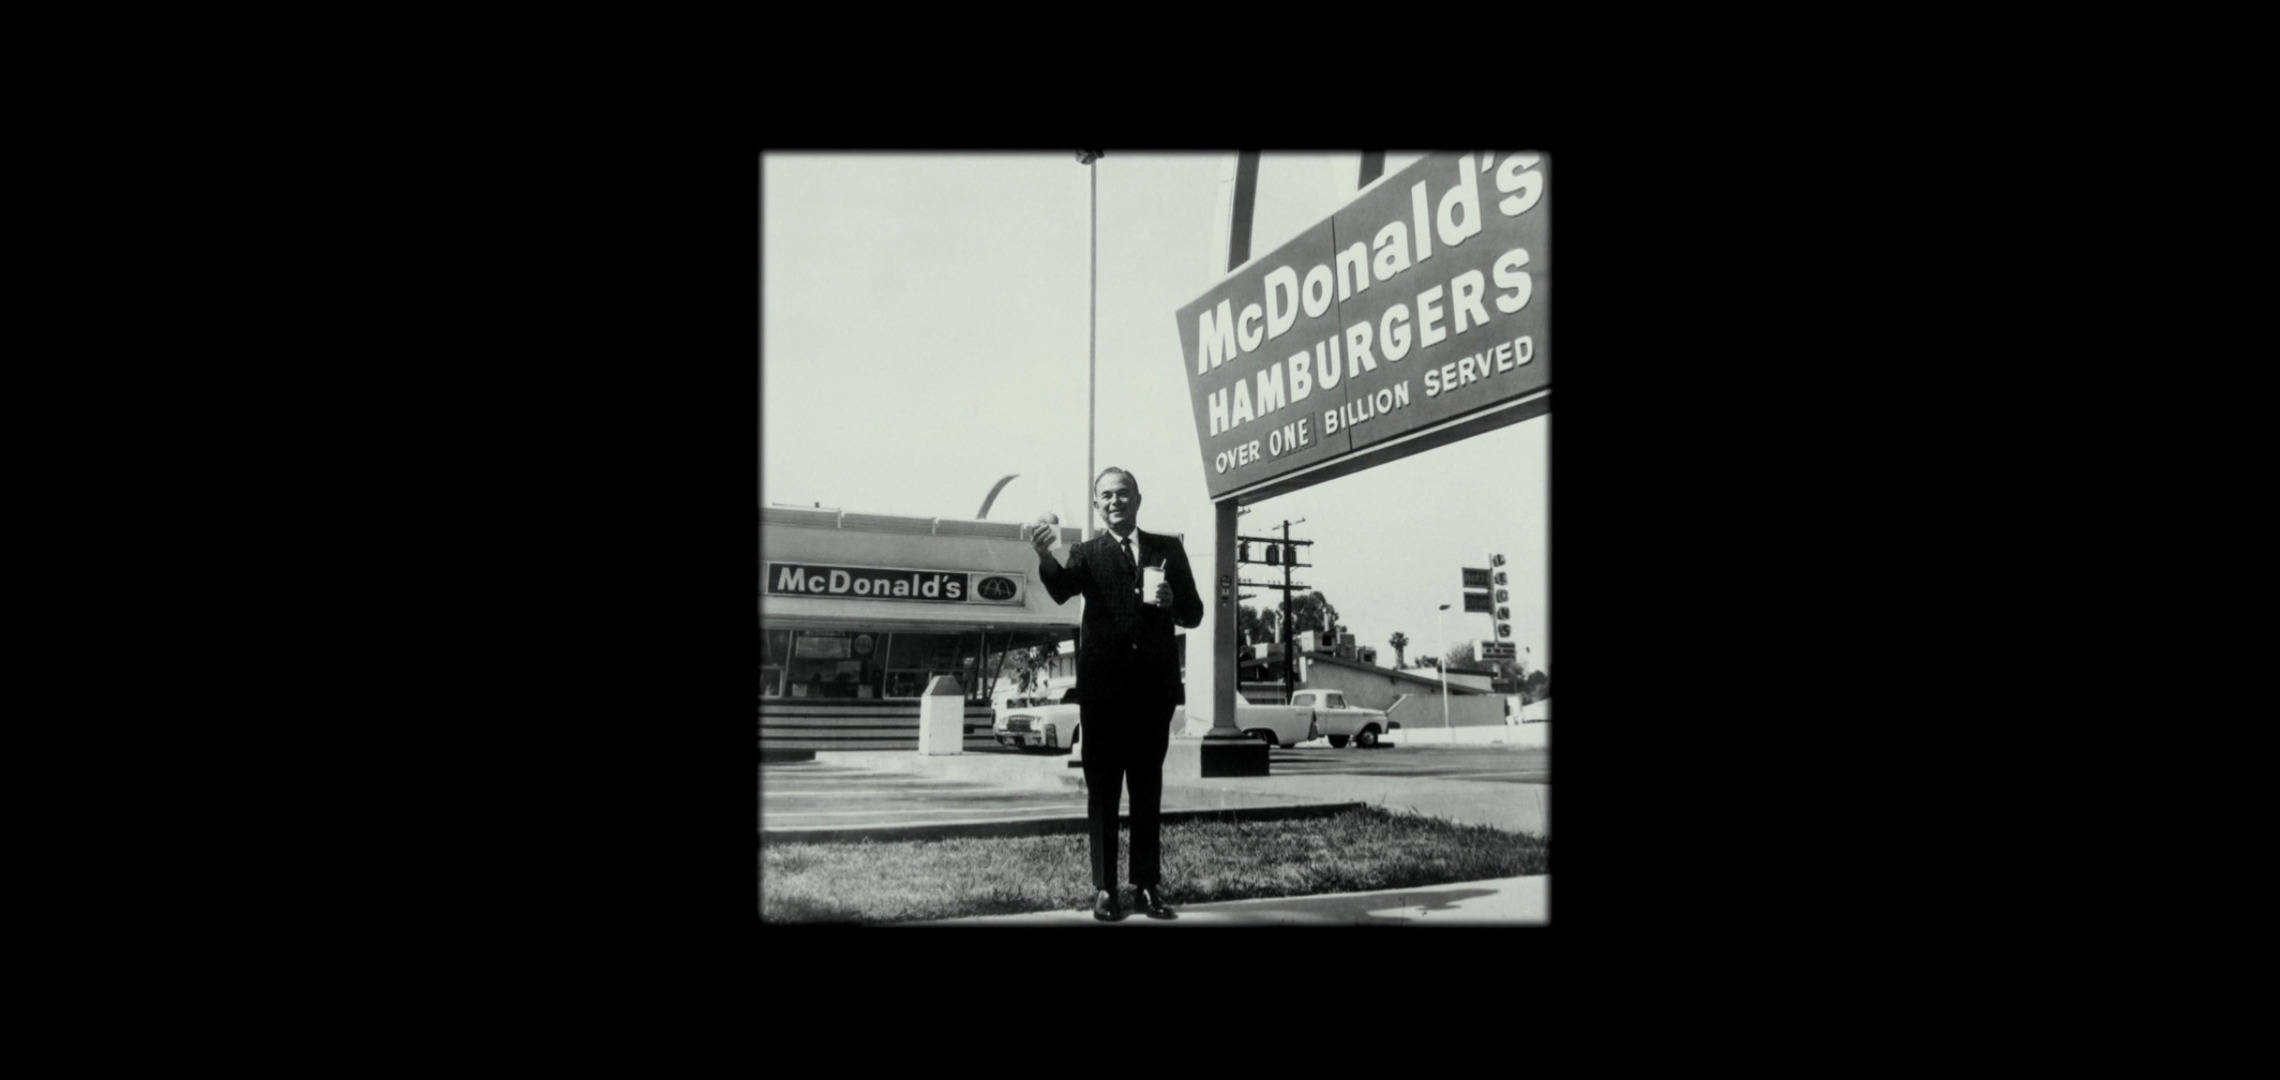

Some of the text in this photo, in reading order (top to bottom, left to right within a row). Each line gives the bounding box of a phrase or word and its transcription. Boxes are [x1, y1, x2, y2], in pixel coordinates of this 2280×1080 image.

[1198, 150, 1544, 376] McDonald's
[1208, 248, 1533, 437] HAMBURGERS
[1215, 335, 1535, 475] OVER ONE BILLION SERVED
[777, 567, 962, 598] McDonald's
